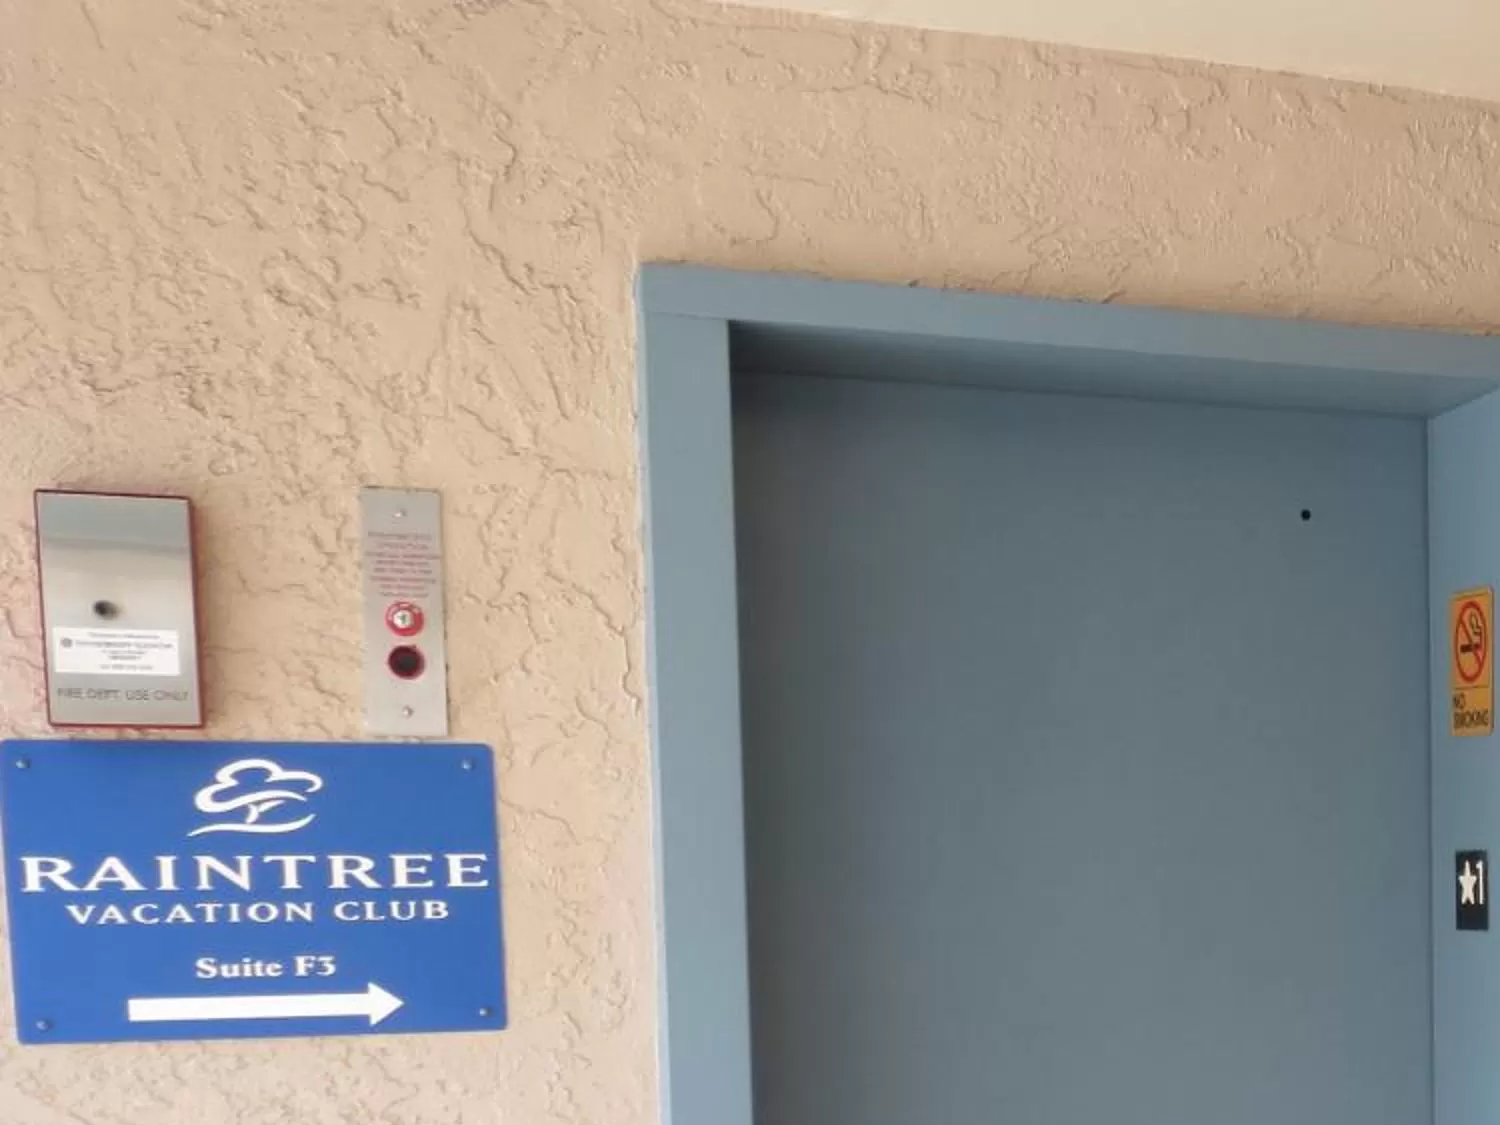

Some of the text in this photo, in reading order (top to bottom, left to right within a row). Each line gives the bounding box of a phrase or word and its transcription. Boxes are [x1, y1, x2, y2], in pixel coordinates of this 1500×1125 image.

[19, 854, 489, 892] RAINTREE
[66, 901, 449, 925] VACATION CLUB
[195, 957, 283, 979] Suite
